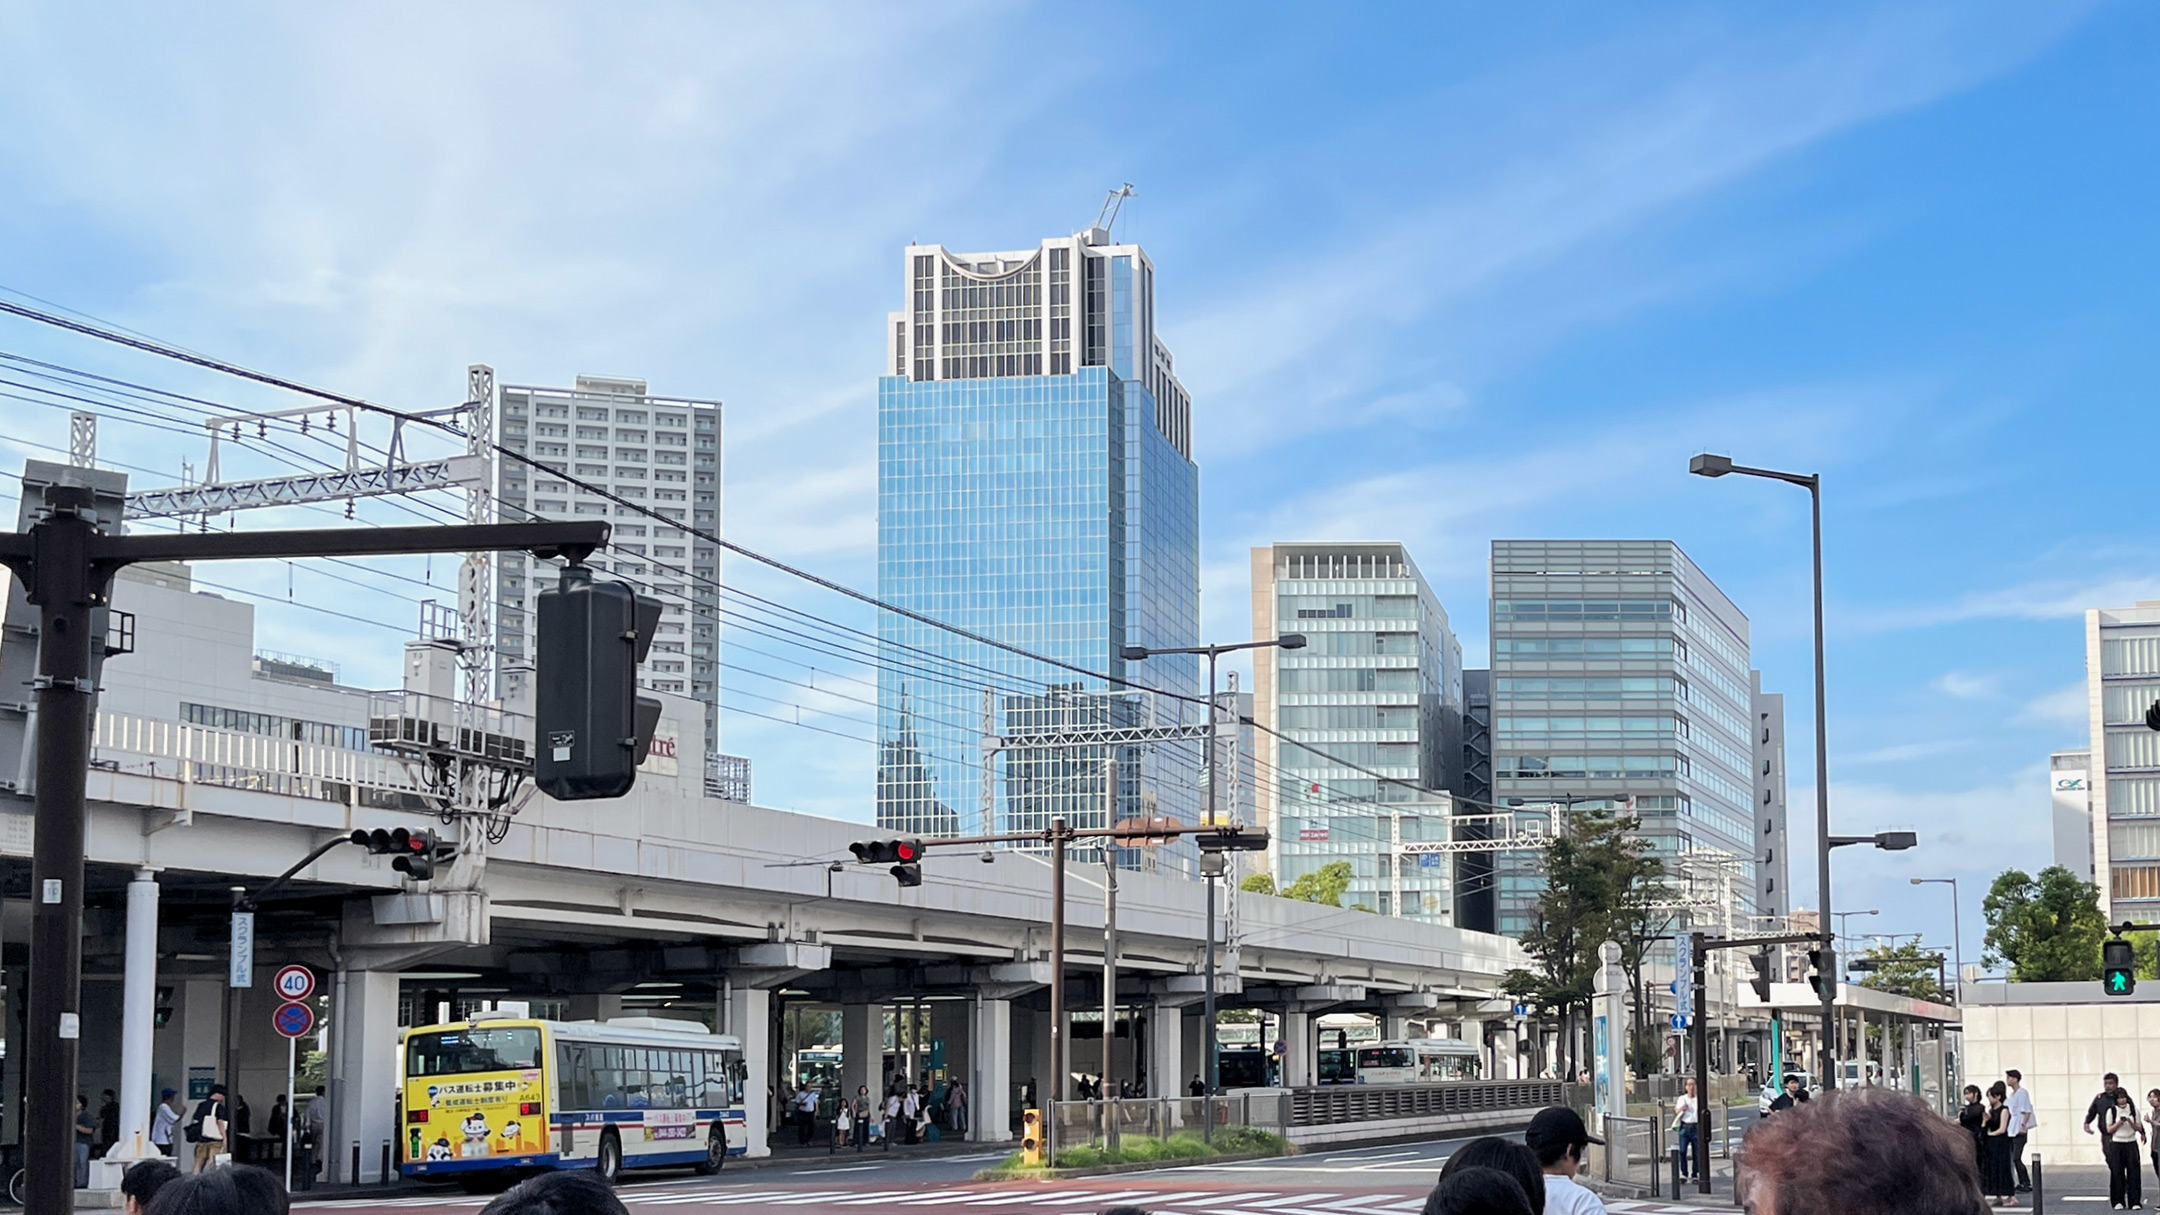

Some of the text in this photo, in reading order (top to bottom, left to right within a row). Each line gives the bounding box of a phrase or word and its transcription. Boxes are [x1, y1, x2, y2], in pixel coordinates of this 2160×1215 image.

[651, 734, 676, 758] tré
[1678, 936, 1688, 1011] スクランブル式
[284, 975, 305, 991] 40
[439, 1081, 516, 1095] バス運転士募集中
[519, 1093, 541, 1102] A643
